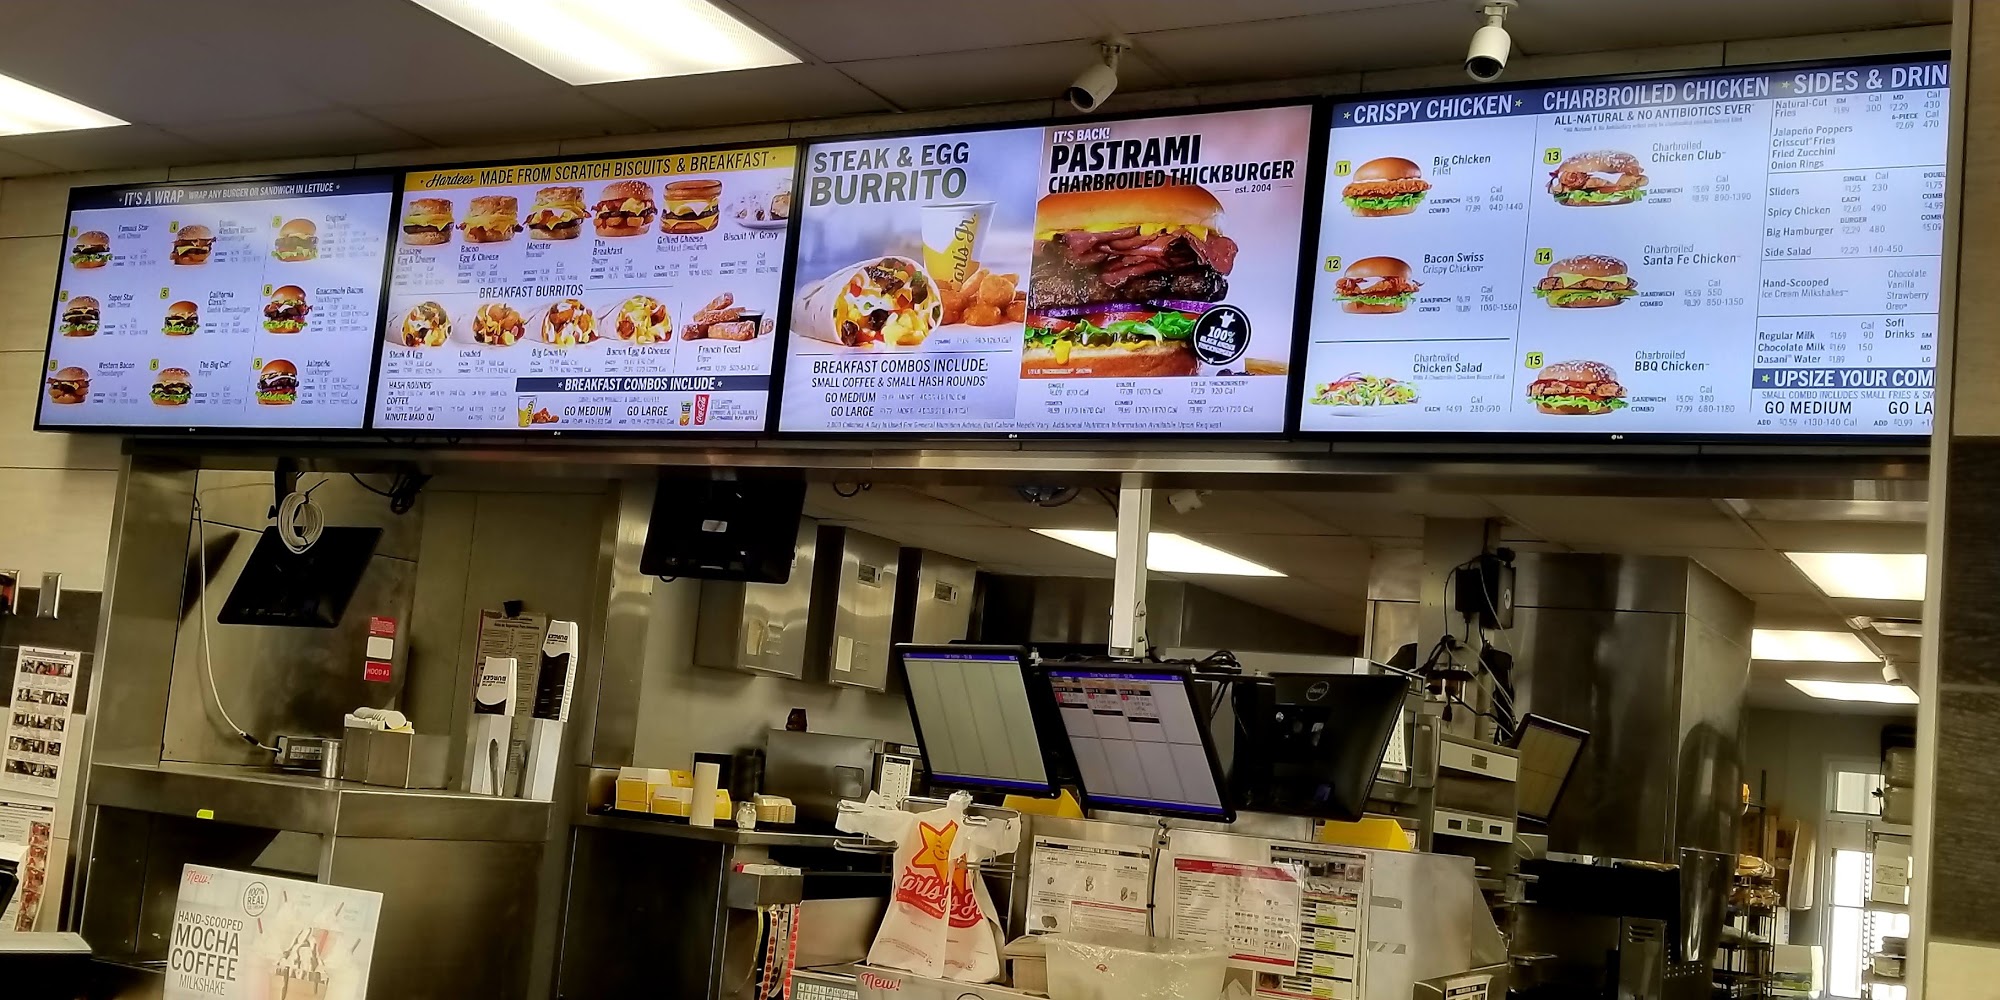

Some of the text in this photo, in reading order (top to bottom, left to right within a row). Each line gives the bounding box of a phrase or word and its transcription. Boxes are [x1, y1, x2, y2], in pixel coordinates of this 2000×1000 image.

[1793, 71, 1859, 93] SIDES
[1866, 69, 1883, 89] &
[1543, 77, 1770, 112] CHARBROILED CHICKEN
[1775, 99, 1827, 109] Natural-Cut
[1354, 95, 1512, 124] CRISPY CHICKEN
[1775, 109, 1796, 117] Fries
[1554, 111, 1623, 126] ALL-NATURAL
[1627, 111, 1633, 120] &
[1637, 110, 1652, 120] NO
[1655, 106, 1721, 119] ANTIBIOTICS
[1724, 104, 1752, 114] EVER
[1923, 120, 1939, 128] 470
[1816, 125, 1853, 135] Poppers
[1053, 128, 1110, 143] IT'S BACK!
[1652, 141, 1701, 151] Charbroiled
[1813, 137, 1835, 145] Fries
[814, 141, 969, 173] STEAK & EGG
[1050, 135, 1201, 173] PASTRAMI
[1547, 152, 1559, 161] 13
[1652, 151, 1694, 163] Chicken
[1772, 148, 1836, 158] Fried Zucchini
[1433, 155, 1491, 167] Big Chicken
[1772, 160, 1824, 169] Onion Rings
[480, 169, 513, 185] MADE
[518, 167, 550, 182] FROM
[555, 162, 611, 181] SCRATCH
[614, 158, 670, 176] BISCUITS
[676, 158, 685, 172] &
[690, 151, 769, 171] BREAKFAST
[1338, 164, 1348, 173] 11
[1049, 160, 1295, 193] CHARBROILED THICKBURGER
[810, 167, 967, 206] BURRITO
[1251, 184, 1271, 192] 2004
[1769, 187, 1800, 195] Sliders
[123, 192, 143, 206] IT'S
[144, 192, 152, 205] A
[154, 190, 184, 203] WRAP
[208, 190, 222, 199] ANY
[222, 188, 248, 198] BURGER
[250, 188, 259, 196] OR
[260, 185, 294, 195] SANDWICH
[295, 185, 303, 194] IN
[305, 183, 334, 193] LETTUCE
[1768, 204, 1887, 218] Spicy Chicken 490
[1766, 225, 1885, 238] Big Hamburger 480
[1644, 245, 1694, 253] Charbroiled
[1765, 247, 1812, 256] Side Salad
[1424, 253, 1484, 264] Bacon Swiss
[1538, 252, 1550, 261] 14
[1643, 254, 1736, 266] Santa Fe Chicken
[950, 245, 969, 284] arl's
[1328, 260, 1339, 268] 12
[1423, 265, 1446, 275] Crispy
[1888, 270, 1927, 278] Chocolate
[1763, 278, 1829, 288] Hand-Scooped
[1887, 281, 1914, 289] Vanilla
[479, 285, 583, 298] BREAKFAST BURRITOS
[1887, 291, 1929, 300] Strawberry
[1886, 319, 1904, 327] Soft
[1208, 326, 1235, 343] 100%
[1759, 332, 1793, 341] Regular
[1796, 331, 1815, 340] Milk
[1885, 330, 1915, 338] Drinks
[1758, 343, 1803, 351] Chocolate
[1806, 343, 1825, 351] Milk
[1635, 351, 1685, 360] Charbroiled
[1794, 355, 1821, 363] Water
[210, 361, 218, 369] Big
[1529, 357, 1541, 365] 15
[1635, 360, 1705, 372] BBQ Chicken
[813, 359, 988, 374] BREAKFAST COMBOS INCLUDE:
[1413, 362, 1482, 373] Chicken Salad
[812, 376, 985, 388] SMALL COFFEE & SMALL HASH ROUNDS
[1774, 370, 1835, 387] UPSIZE
[1840, 369, 1887, 387] YOUR
[564, 377, 715, 391] BREAKFAST COMBOS INCLUDE
[825, 393, 876, 402] GO MEDIUM
[1762, 391, 1786, 399] SMALL
[1789, 391, 1817, 399] COMBO
[1820, 391, 1858, 399] INCLUDES
[1861, 391, 1886, 399] SMALL
[564, 406, 668, 416] GO MEDIUM GO LARGE
[831, 407, 874, 416] GO LARGE
[1765, 401, 1785, 414] GO
[1790, 401, 1852, 414] MEDIUM
[1888, 401, 1909, 414] GO
[385, 413, 408, 421] MINUTE
[186, 870, 214, 884] New!
[900, 874, 942, 900] arl's
[247, 897, 264, 905] REAL
[178, 911, 243, 931] HAND-SCOOPED
[175, 924, 239, 956] MOCHA
[171, 948, 238, 981] COFFEE
[179, 974, 225, 995] MILKSHAKE
[861, 973, 901, 990] New!
